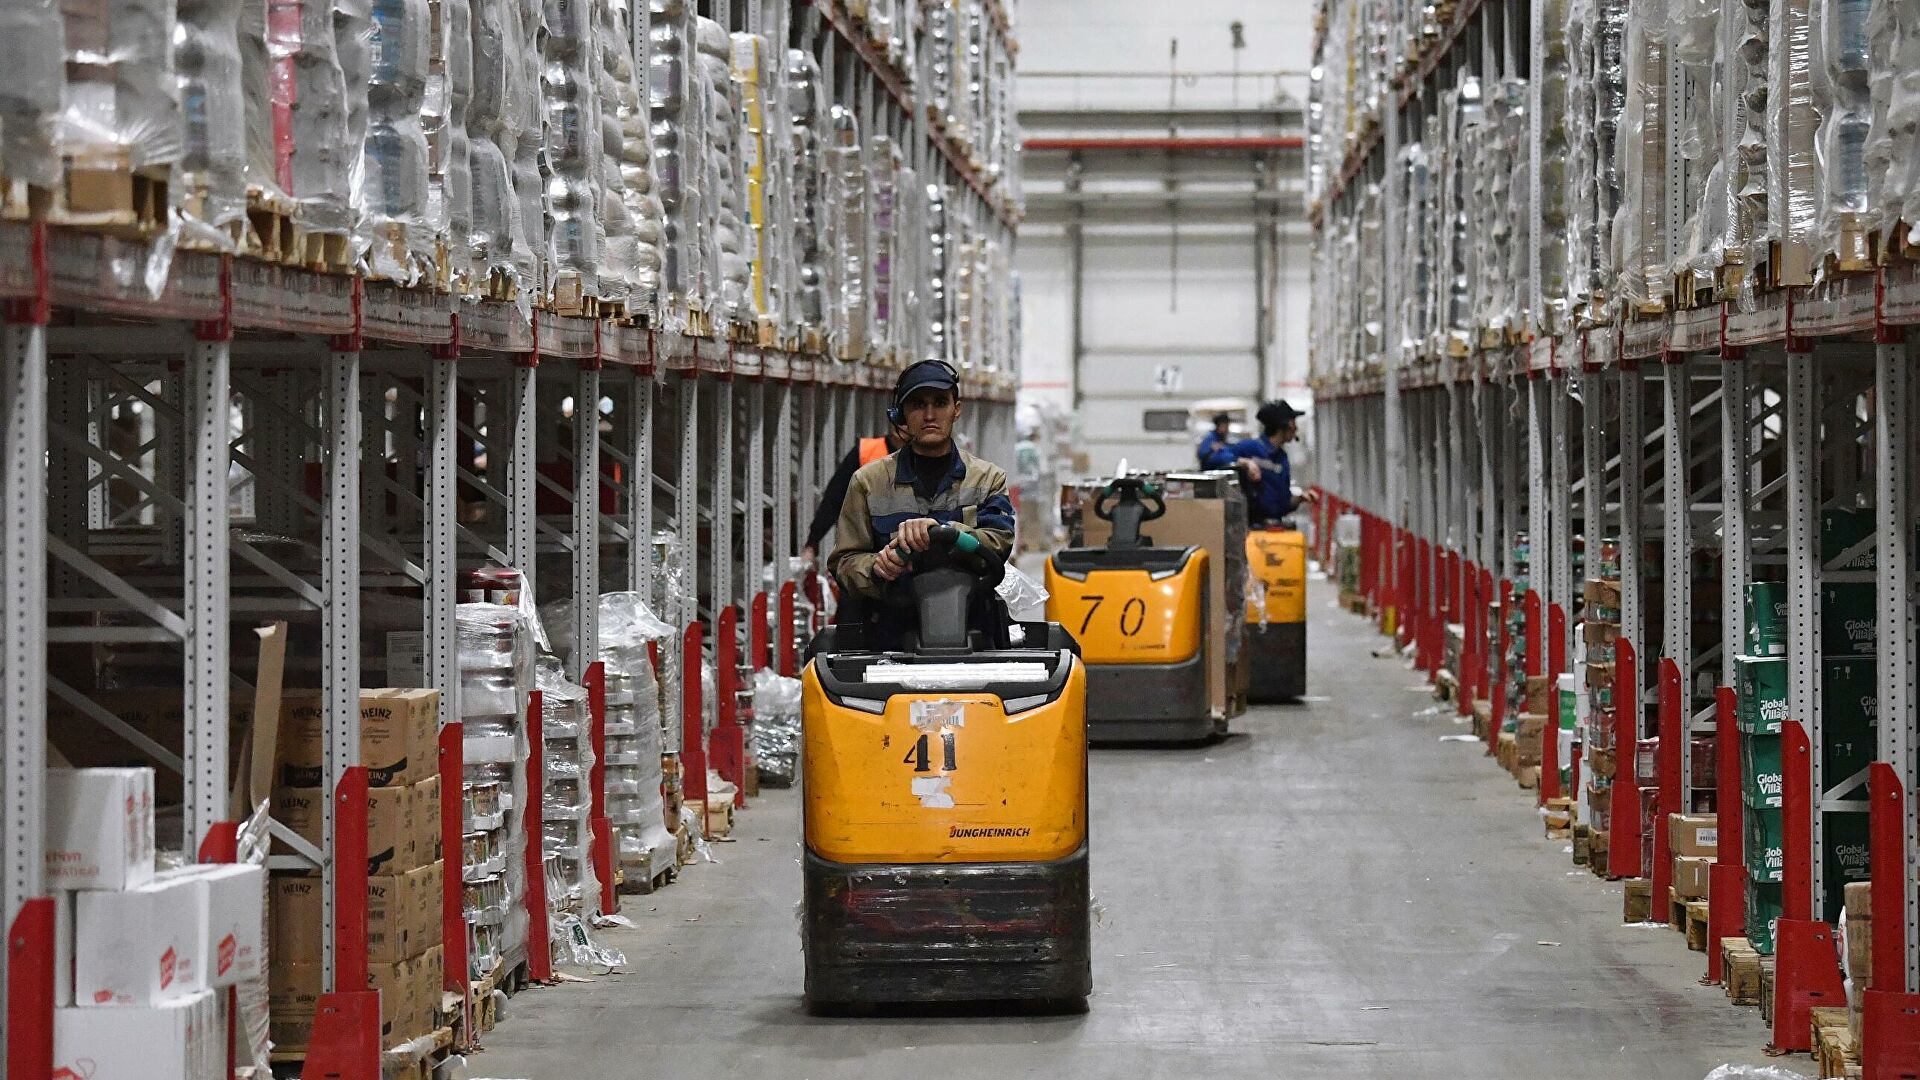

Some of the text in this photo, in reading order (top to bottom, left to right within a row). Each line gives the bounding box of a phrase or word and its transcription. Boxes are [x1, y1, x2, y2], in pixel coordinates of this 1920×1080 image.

[361, 707, 391, 720] HEINZ
[903, 734, 957, 772] 41
[1757, 773, 1782, 784] Globa
[280, 797, 310, 809] HEINZ
[949, 826, 1030, 838] JUNGHEINRICH
[1835, 843, 1869, 856] Global
[283, 884, 311, 895] HEINZ
[368, 885, 385, 898] INZ
